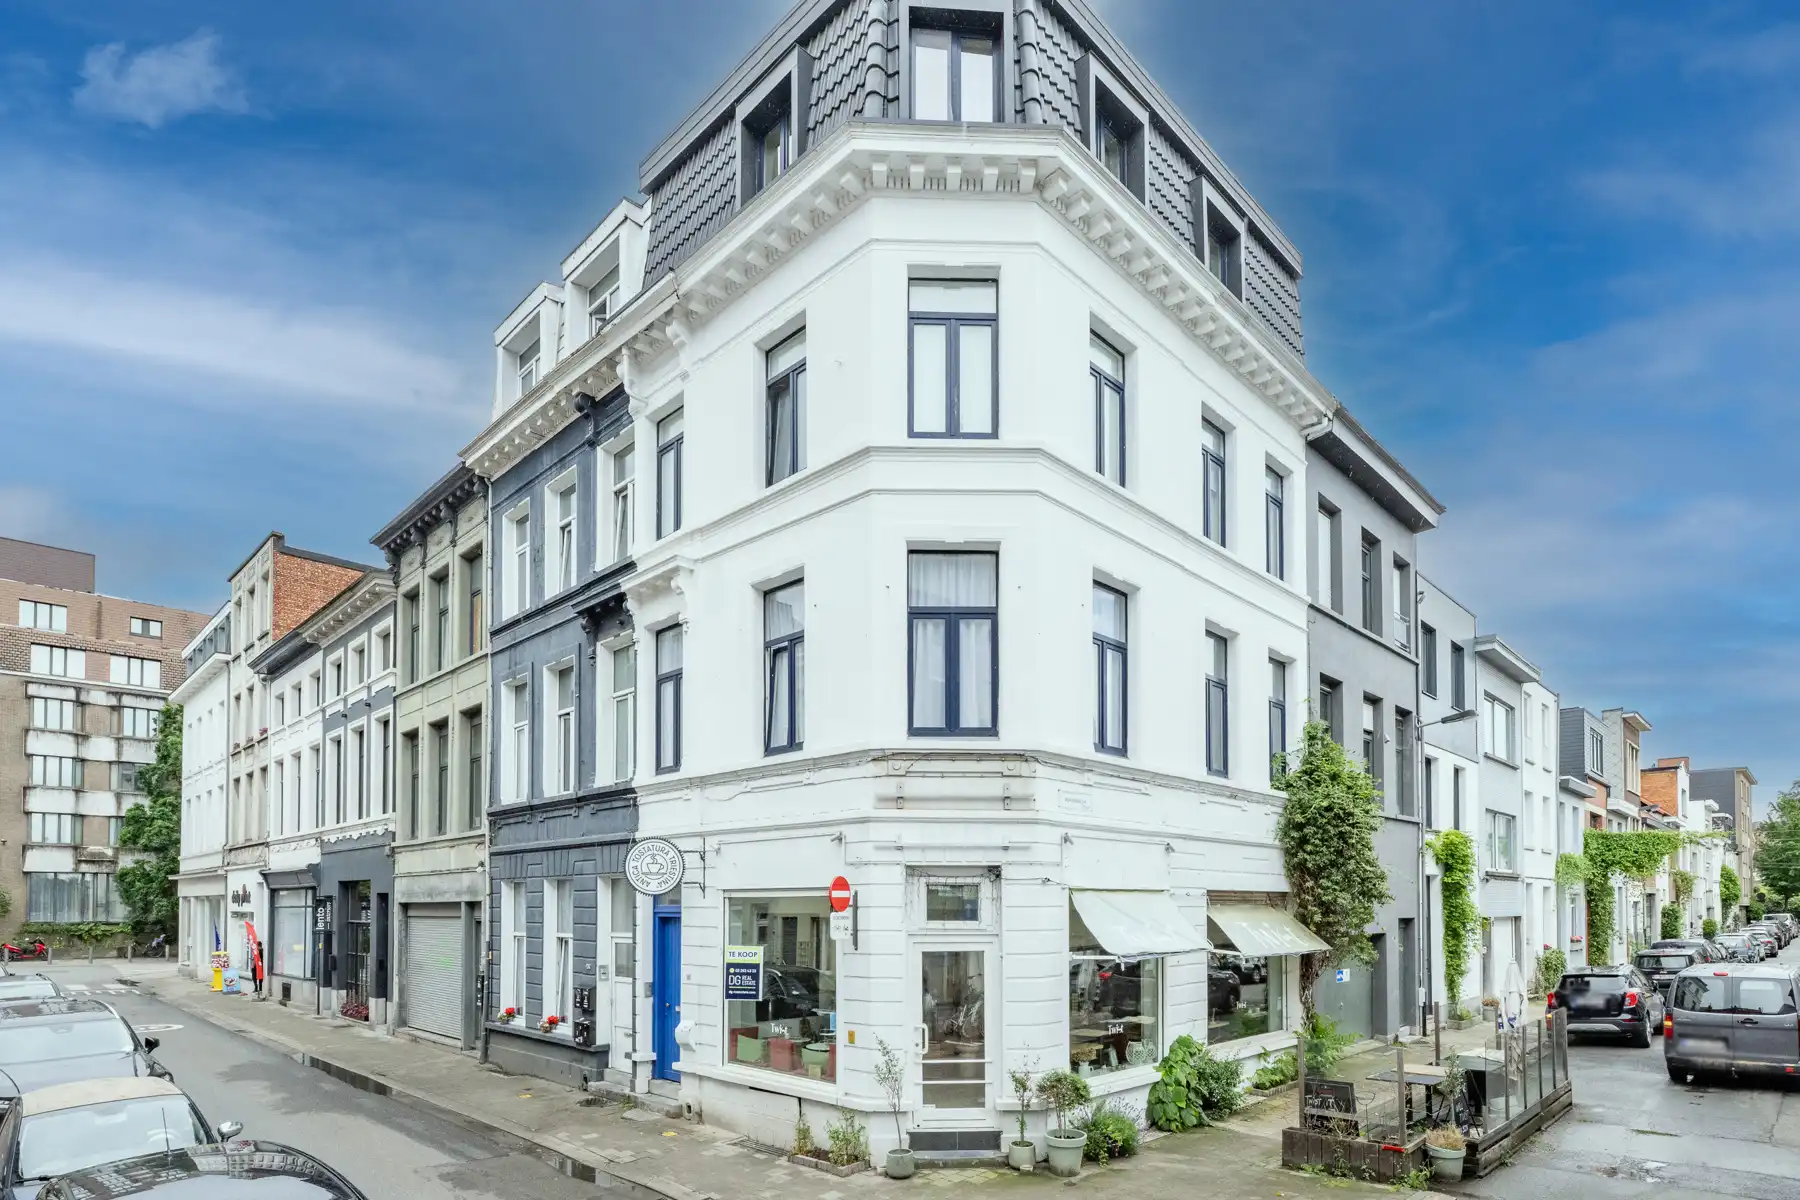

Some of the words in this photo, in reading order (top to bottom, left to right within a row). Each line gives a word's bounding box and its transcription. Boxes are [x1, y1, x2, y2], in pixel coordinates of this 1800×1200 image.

[632, 844, 670, 863] TOSTATURA
[632, 865, 651, 887] ANTICA
[656, 855, 678, 888] TRIESTINA
[315, 907, 325, 930] lento
[728, 975, 741, 986] DG
